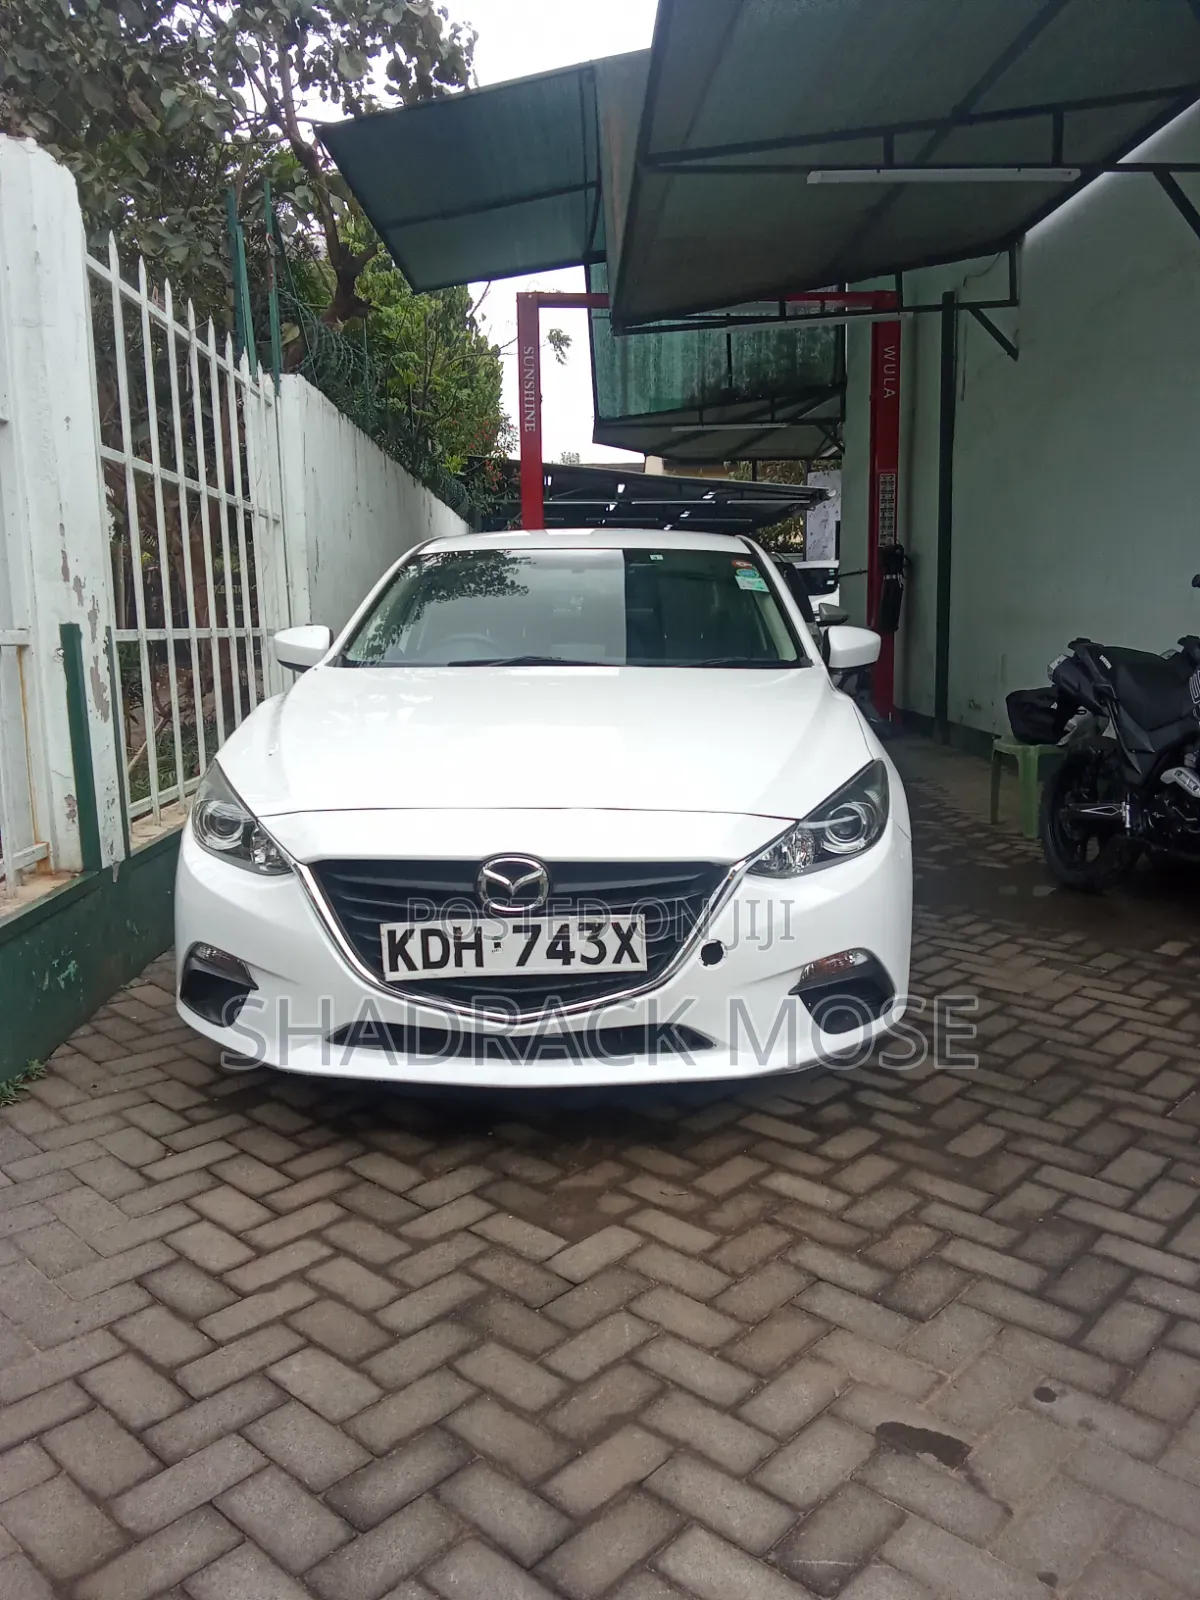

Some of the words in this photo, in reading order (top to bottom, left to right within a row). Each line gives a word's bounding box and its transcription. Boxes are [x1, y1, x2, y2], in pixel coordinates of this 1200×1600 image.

[523, 346, 536, 432] SUNSHINE
[883, 345, 896, 399] WULA
[387, 926, 485, 973] KDH
[511, 921, 641, 967] 743X
